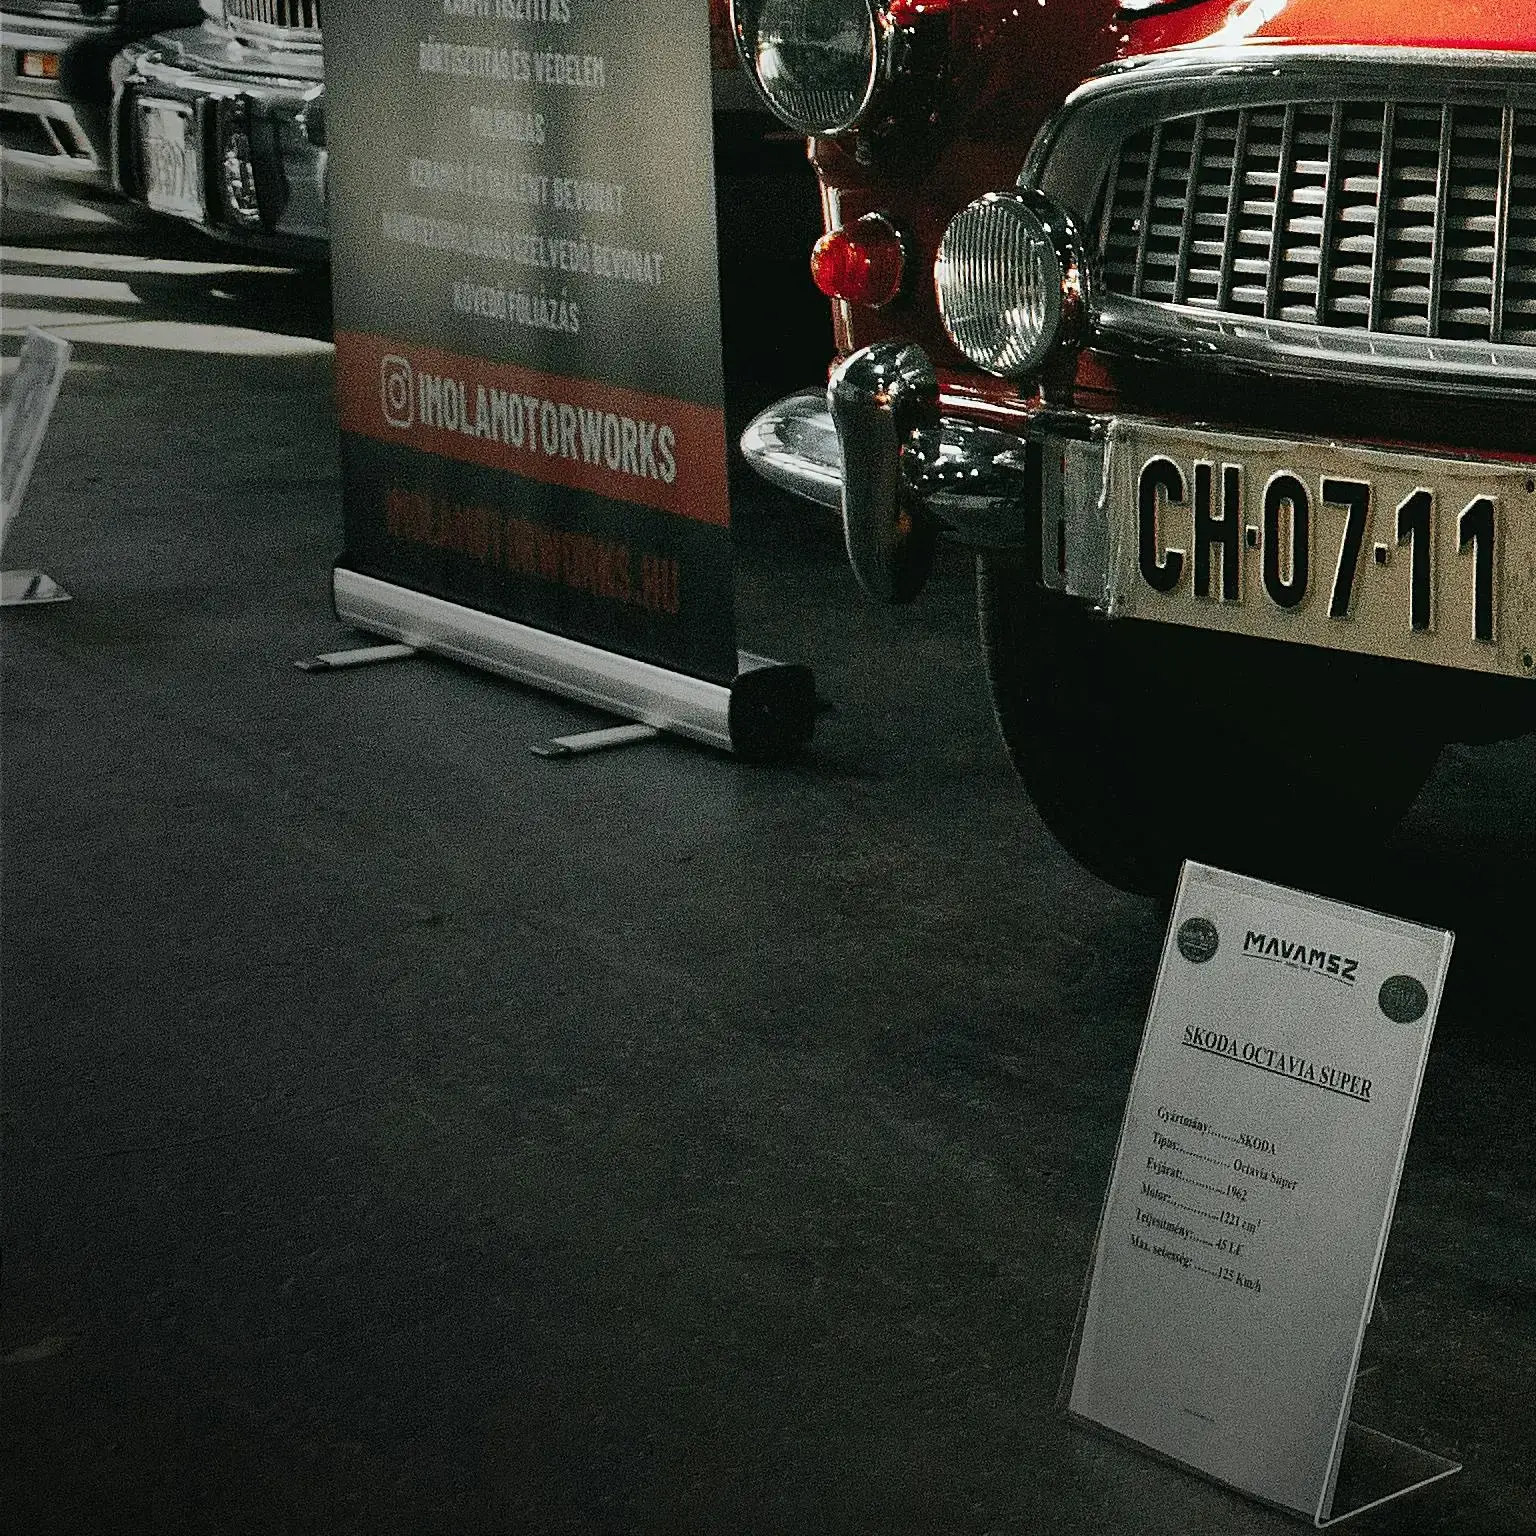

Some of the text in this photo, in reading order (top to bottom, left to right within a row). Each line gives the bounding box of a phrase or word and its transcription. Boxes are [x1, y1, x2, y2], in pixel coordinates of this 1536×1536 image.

[534, 46, 606, 88] VÉDELEM
[418, 372, 677, 485] IMOLAMOTORWORKS
[1243, 930, 1360, 982] MAVAMSZ
[1184, 1023, 1373, 1099] SKODA OCTAVIA SUPER
[1226, 1185, 1248, 1202] 1962
[1233, 1159, 1268, 1180] Octavia
[1270, 1171, 1298, 1191] Super
[1218, 1266, 1235, 1282] 125
